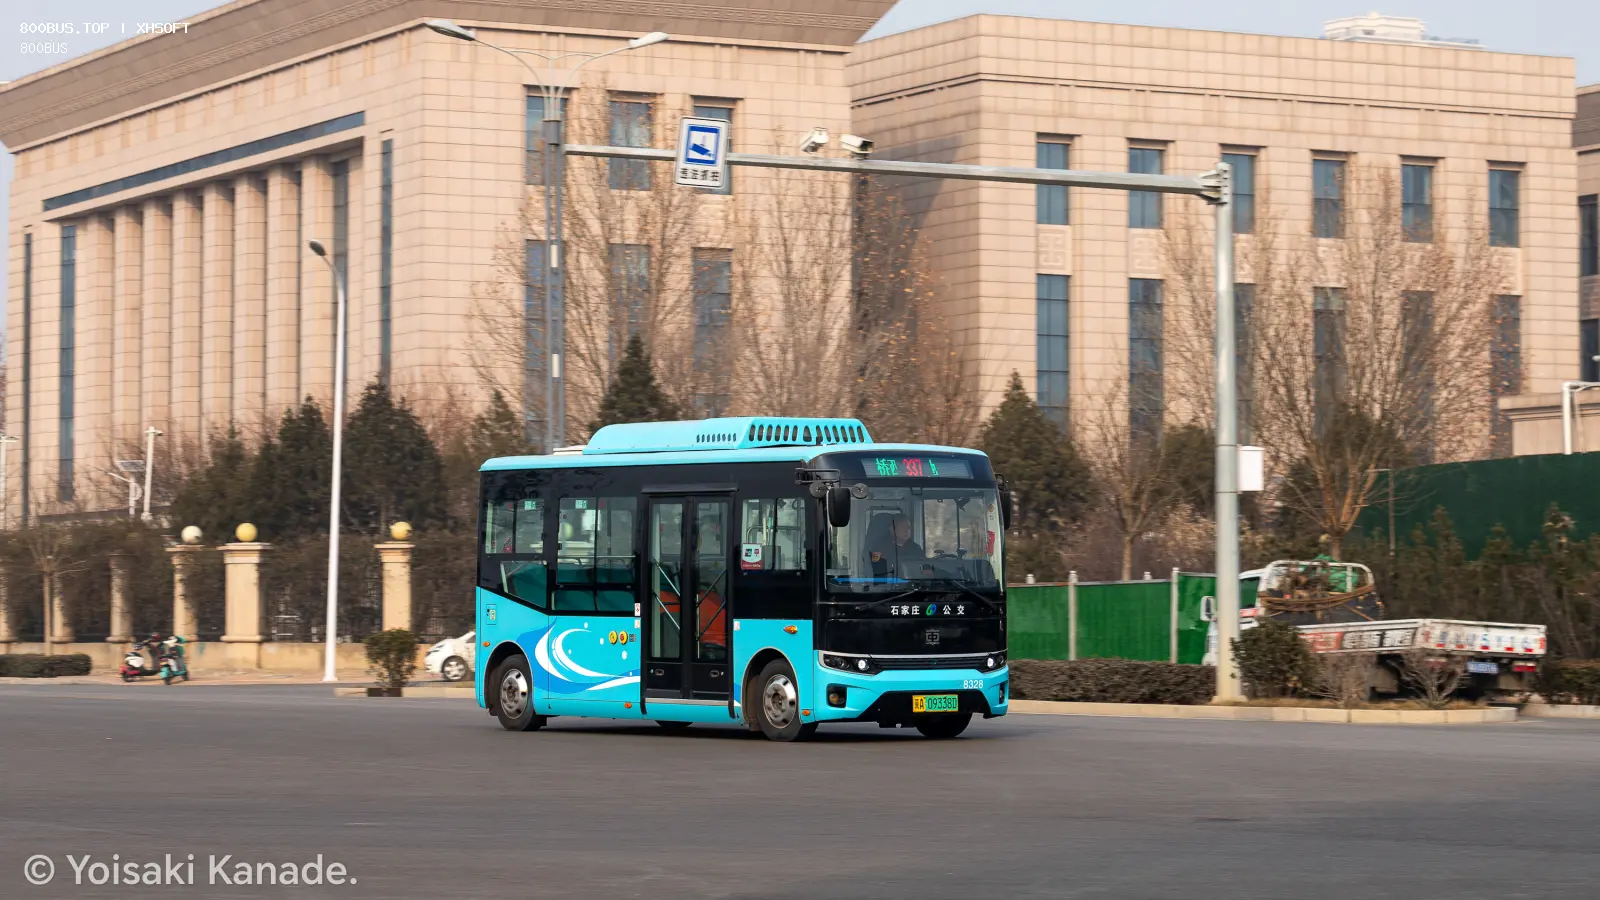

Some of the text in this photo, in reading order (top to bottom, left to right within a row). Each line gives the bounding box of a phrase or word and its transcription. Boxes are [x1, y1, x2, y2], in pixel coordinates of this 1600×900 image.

[890, 605, 965, 615] 石家庄 公交
[963, 680, 983, 689] 8328
